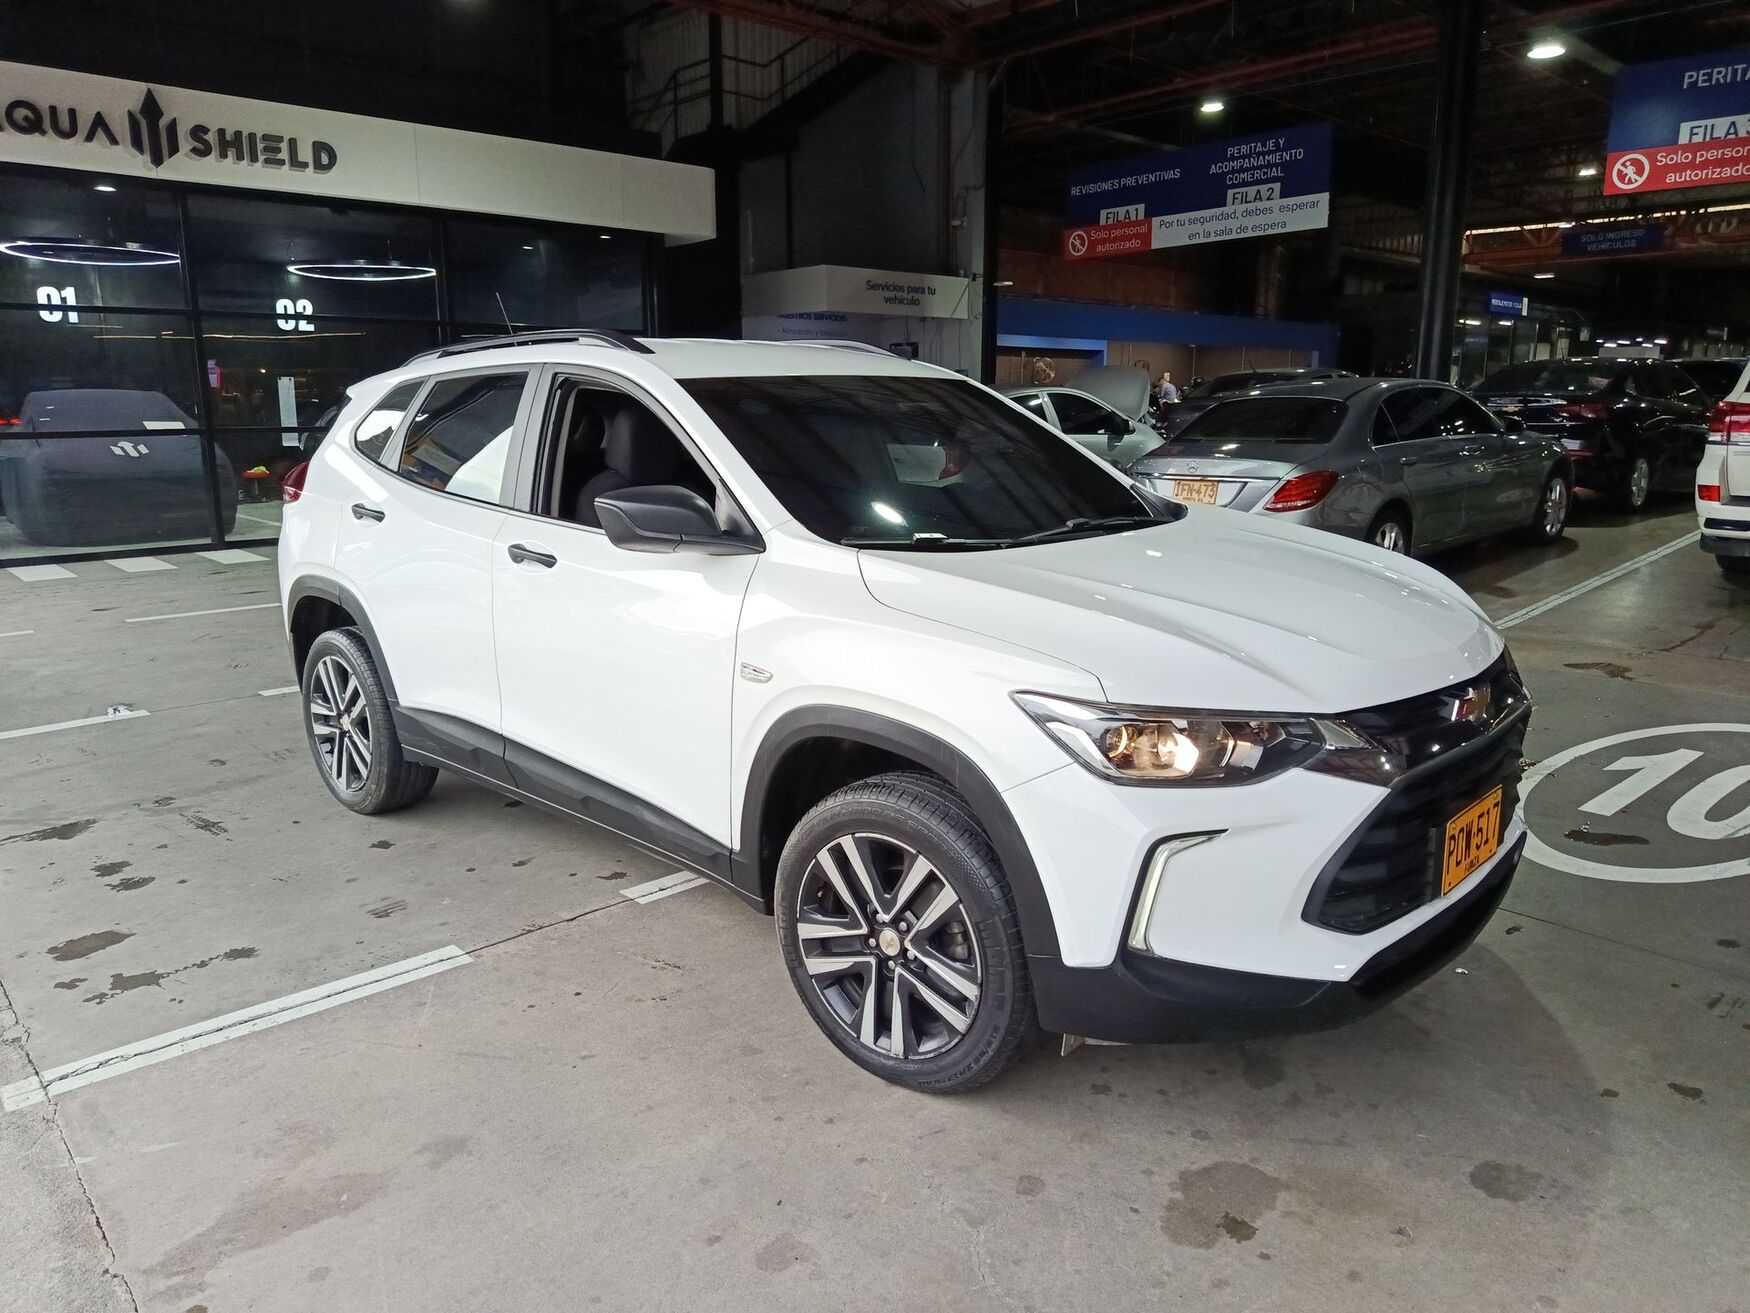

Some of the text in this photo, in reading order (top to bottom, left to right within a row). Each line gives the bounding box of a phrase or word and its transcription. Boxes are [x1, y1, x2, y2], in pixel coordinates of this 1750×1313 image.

[0, 100, 338, 173] QUA SHIELD
[1688, 120, 1739, 143] FILA
[1227, 137, 1286, 158] PERITAJE Y
[1656, 150, 1692, 166] Solo
[1209, 148, 1304, 175] ACOMPAÑAMIENTO
[1071, 168, 1181, 197] REVISIONES PREVENTIVAS
[1226, 166, 1284, 185] COMERCIAL
[1232, 187, 1275, 206] FILA 2
[1105, 208, 1139, 224] FILA 1
[1159, 200, 1320, 230] Por tu seguridad, debes esperar
[1090, 224, 1148, 240] Solo personal
[1188, 220, 1287, 241] en la sala de espera
[1096, 238, 1141, 252] autorizado
[865, 280, 936, 296] Servicios para tu
[37, 286, 78, 323] 01
[276, 298, 315, 331] 02
